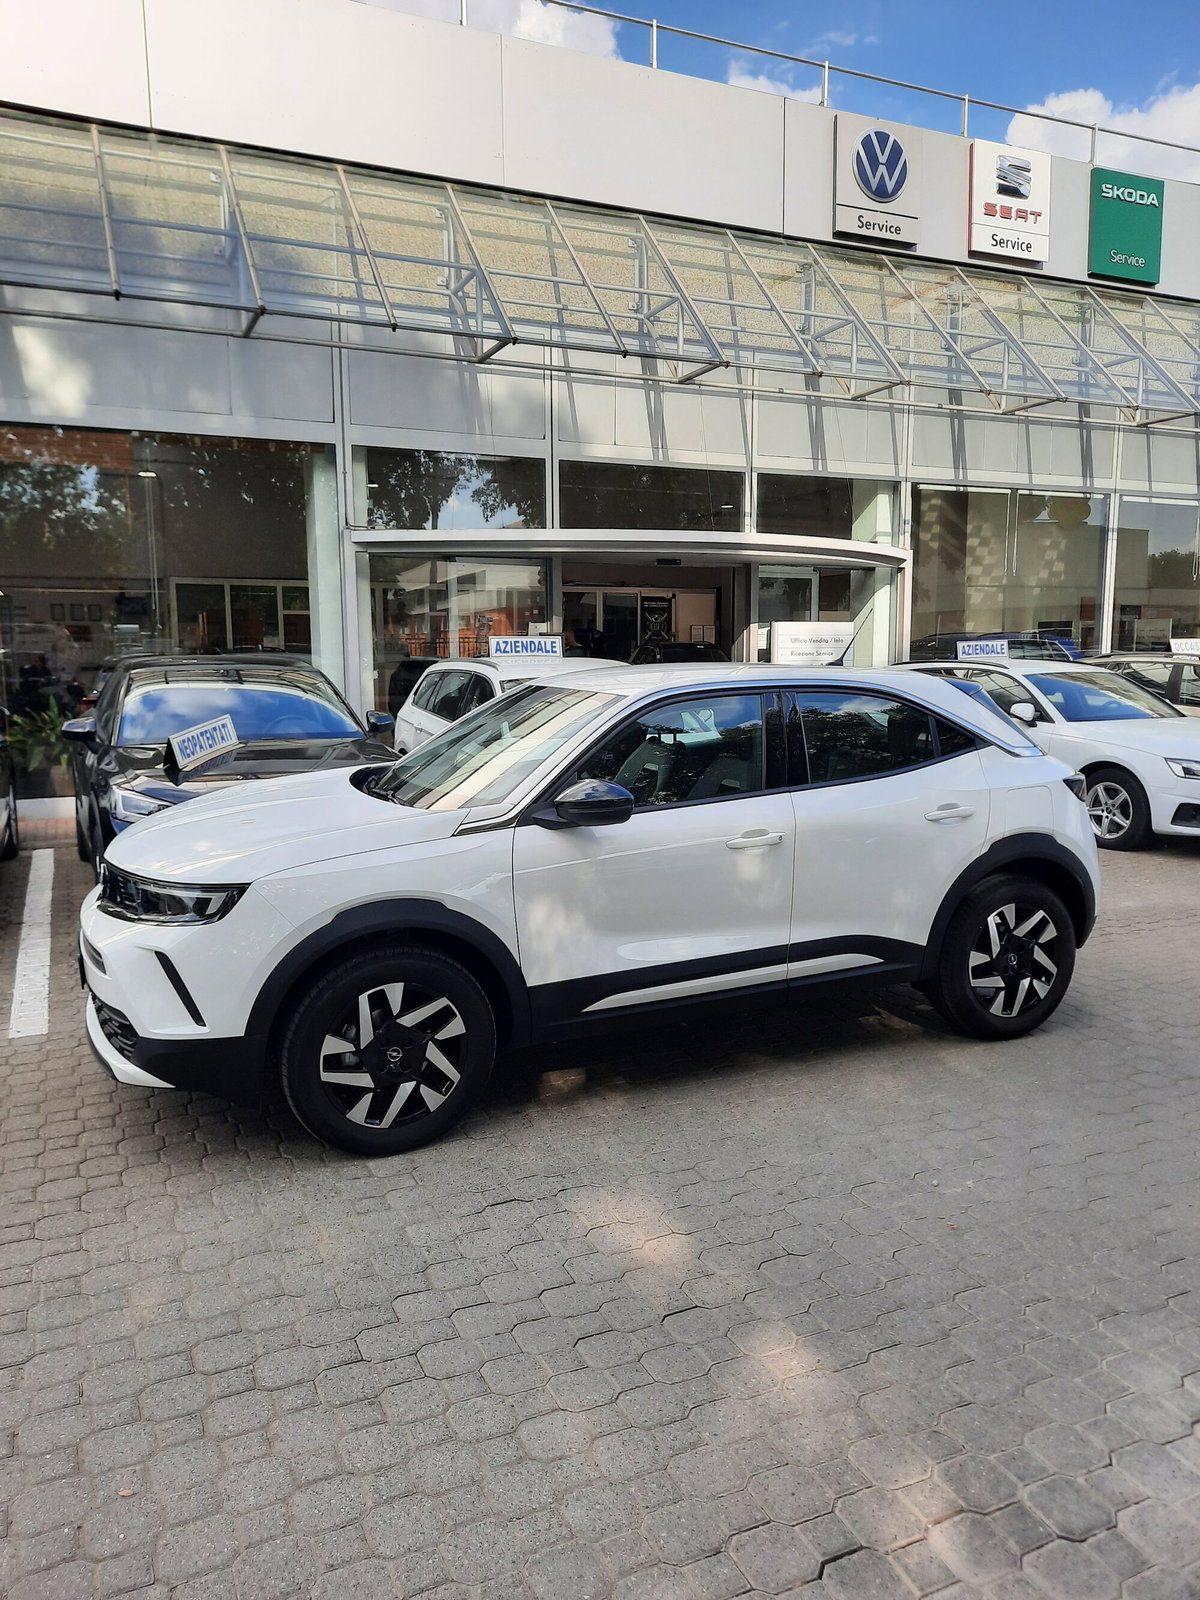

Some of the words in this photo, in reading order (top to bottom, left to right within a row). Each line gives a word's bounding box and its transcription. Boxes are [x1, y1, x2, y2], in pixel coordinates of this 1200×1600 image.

[1101, 184, 1159, 207] SKODA
[983, 202, 1042, 224] SEAT
[857, 215, 901, 235] Service
[991, 234, 1032, 252] Service
[1110, 249, 1145, 267] Service
[495, 640, 557, 654] AZIENDALE
[961, 643, 1005, 656] AZIENDALE
[177, 723, 232, 760] NEOPATENTATI
